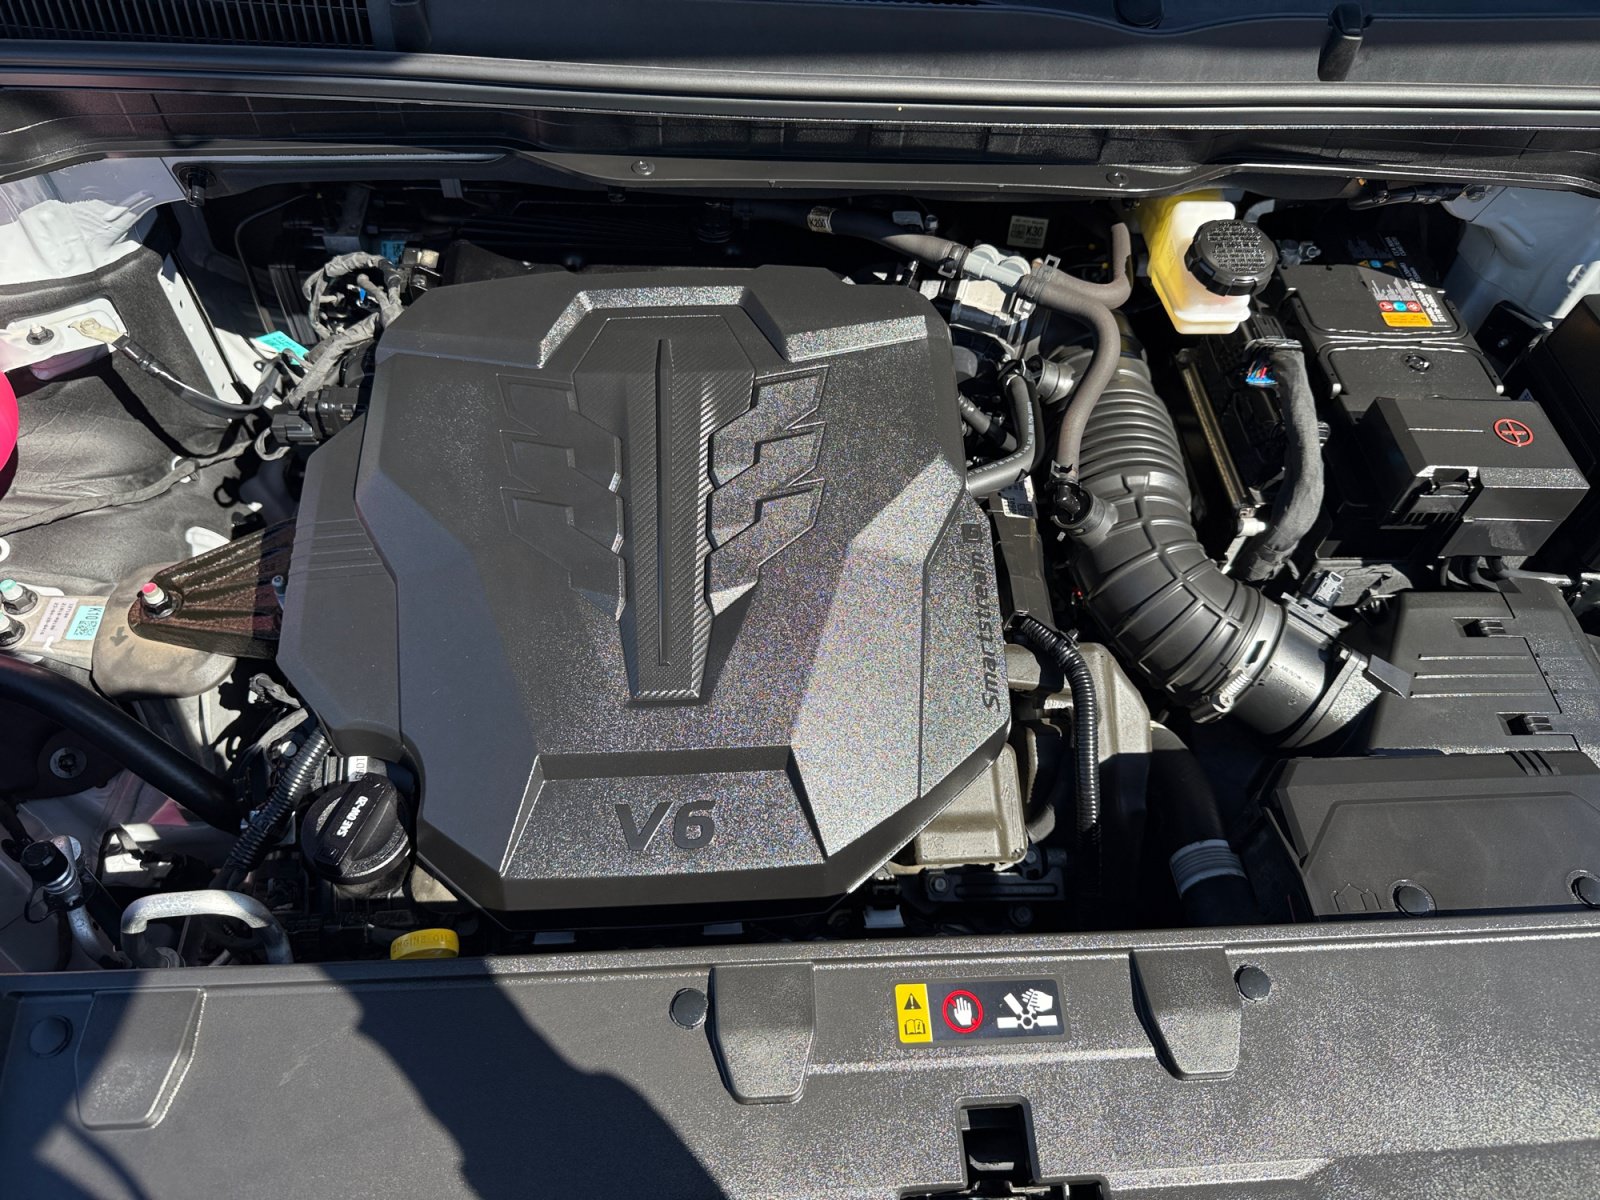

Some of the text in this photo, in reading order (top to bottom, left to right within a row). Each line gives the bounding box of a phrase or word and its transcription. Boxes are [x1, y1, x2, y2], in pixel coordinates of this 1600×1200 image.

[85, 607, 103, 620] K10
[971, 554, 1001, 713] Smartstream
[336, 818, 354, 838] SAE
[614, 799, 716, 851] V6
